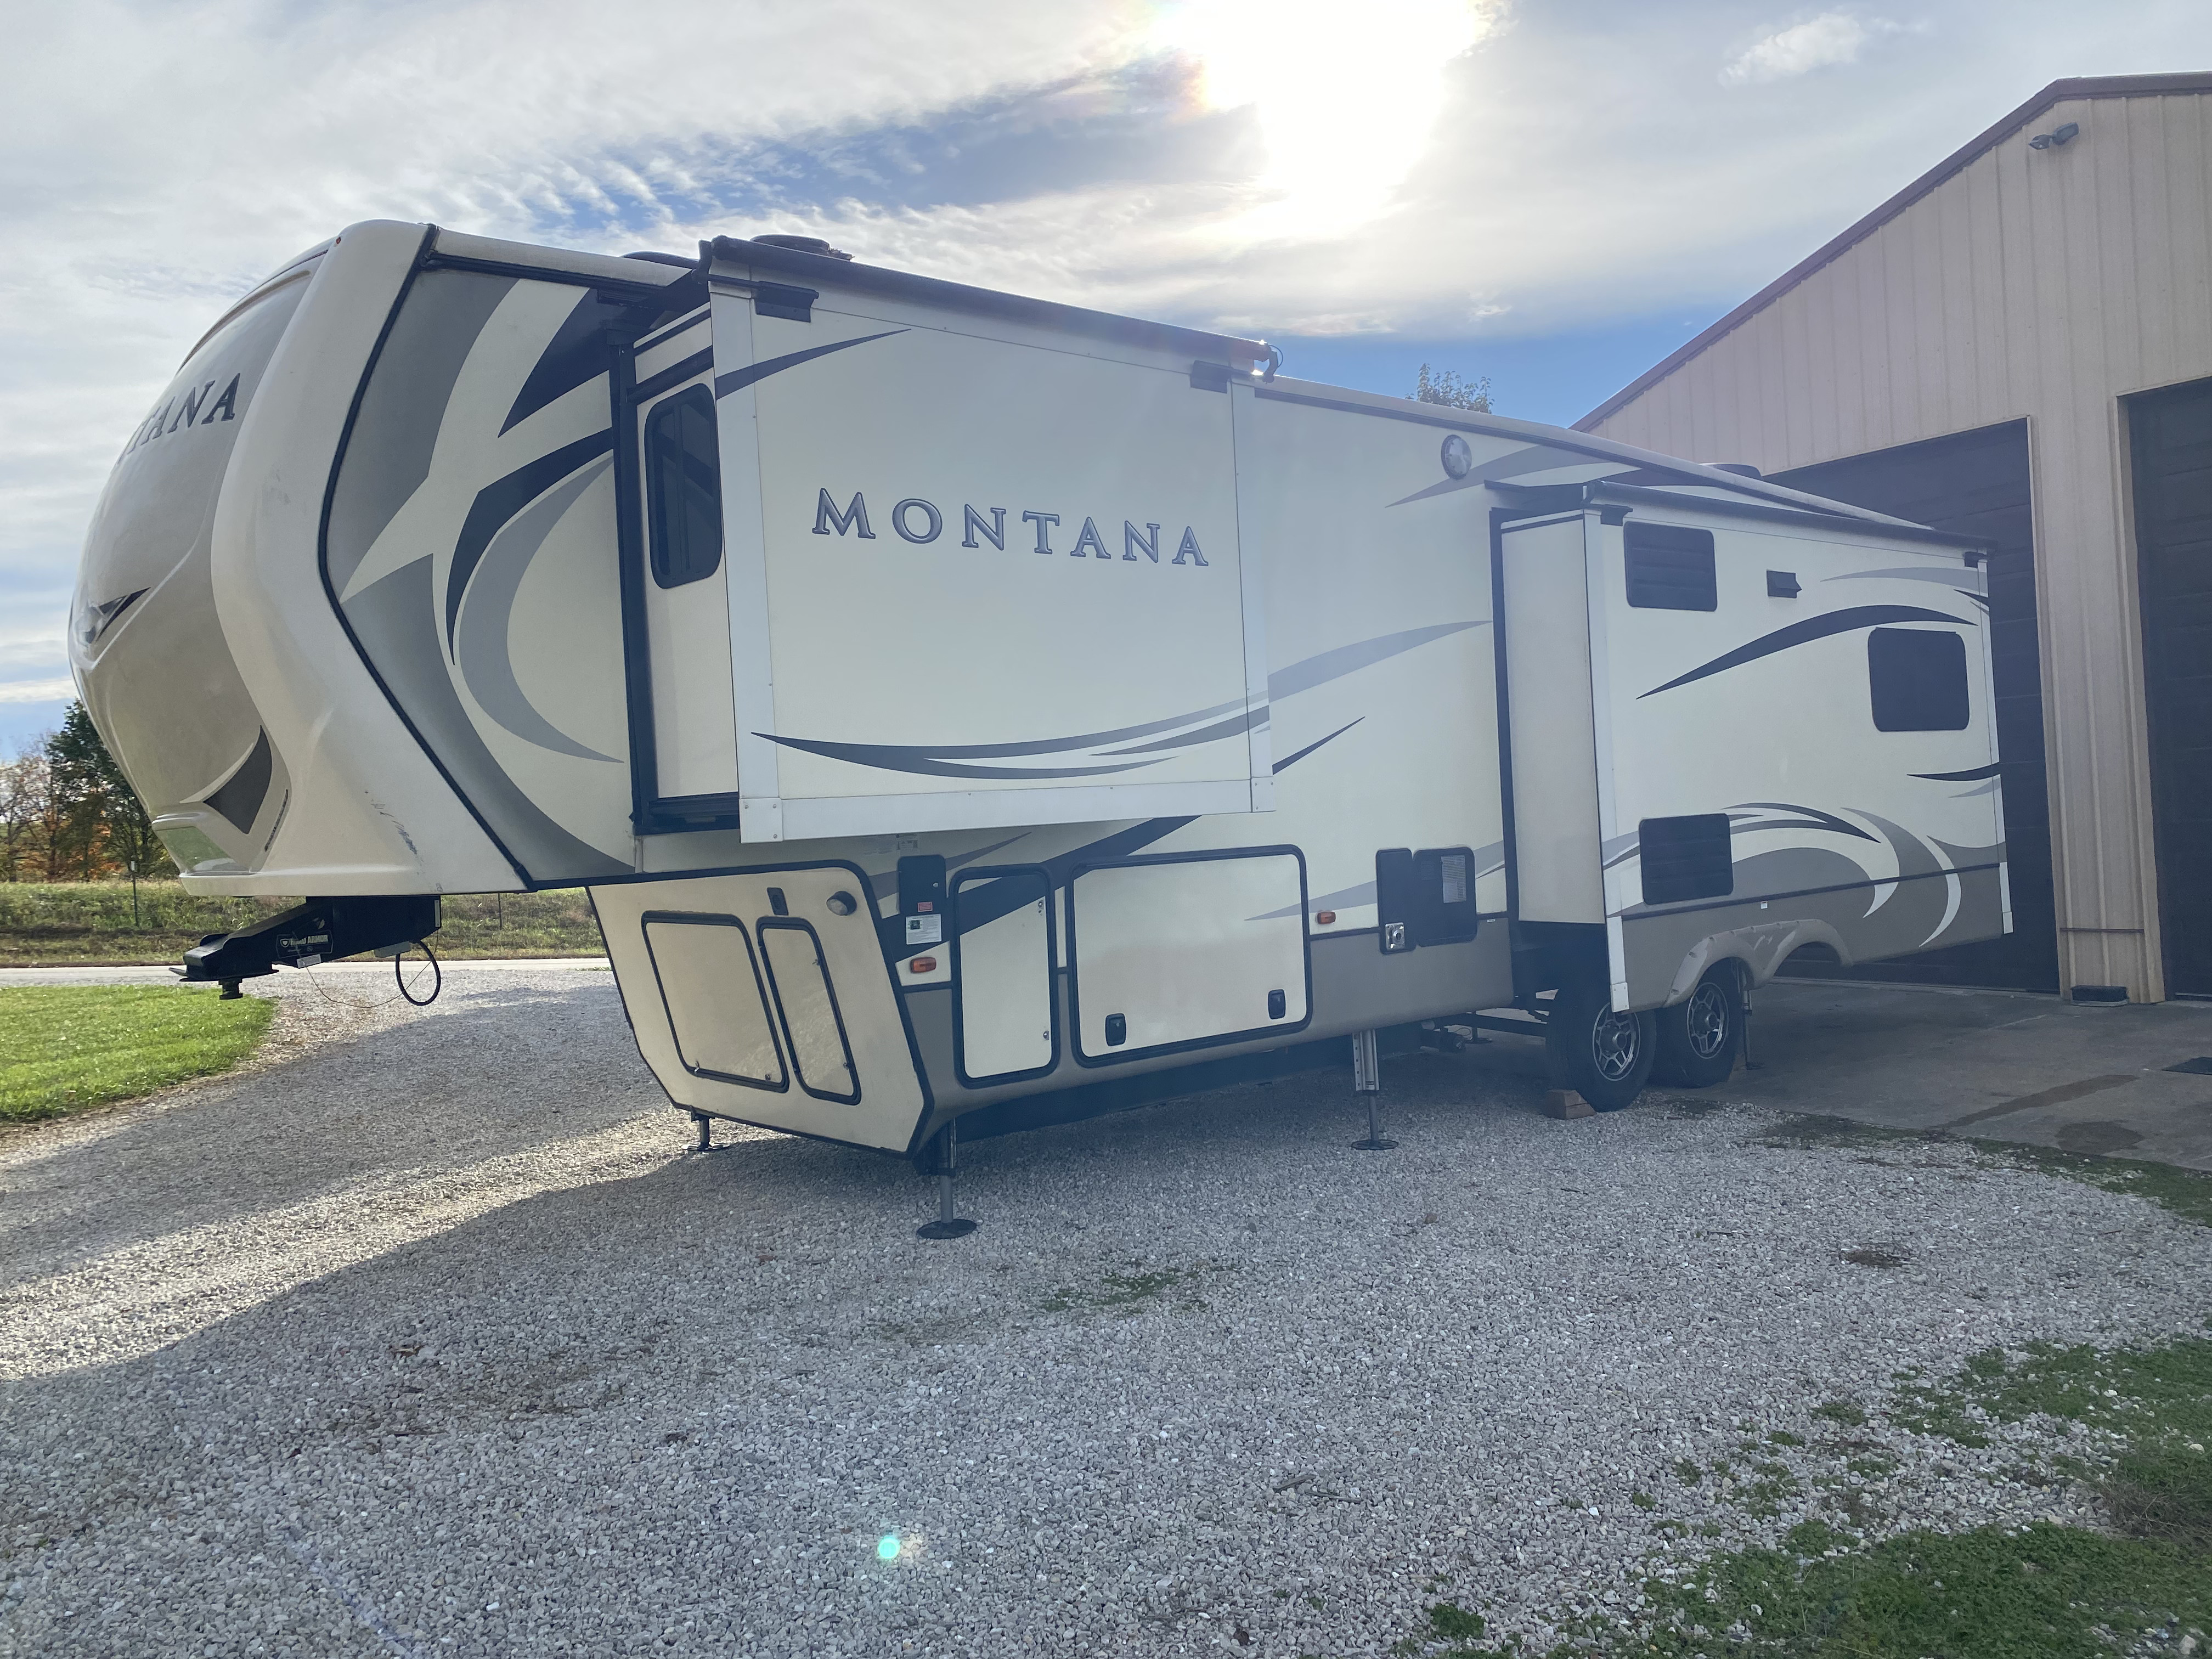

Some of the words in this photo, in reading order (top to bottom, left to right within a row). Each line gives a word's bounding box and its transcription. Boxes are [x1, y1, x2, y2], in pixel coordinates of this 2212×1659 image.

[117, 373, 241, 465] TANA
[811, 487, 1210, 567] MONTANA
[307, 934, 328, 944] ARMOR
